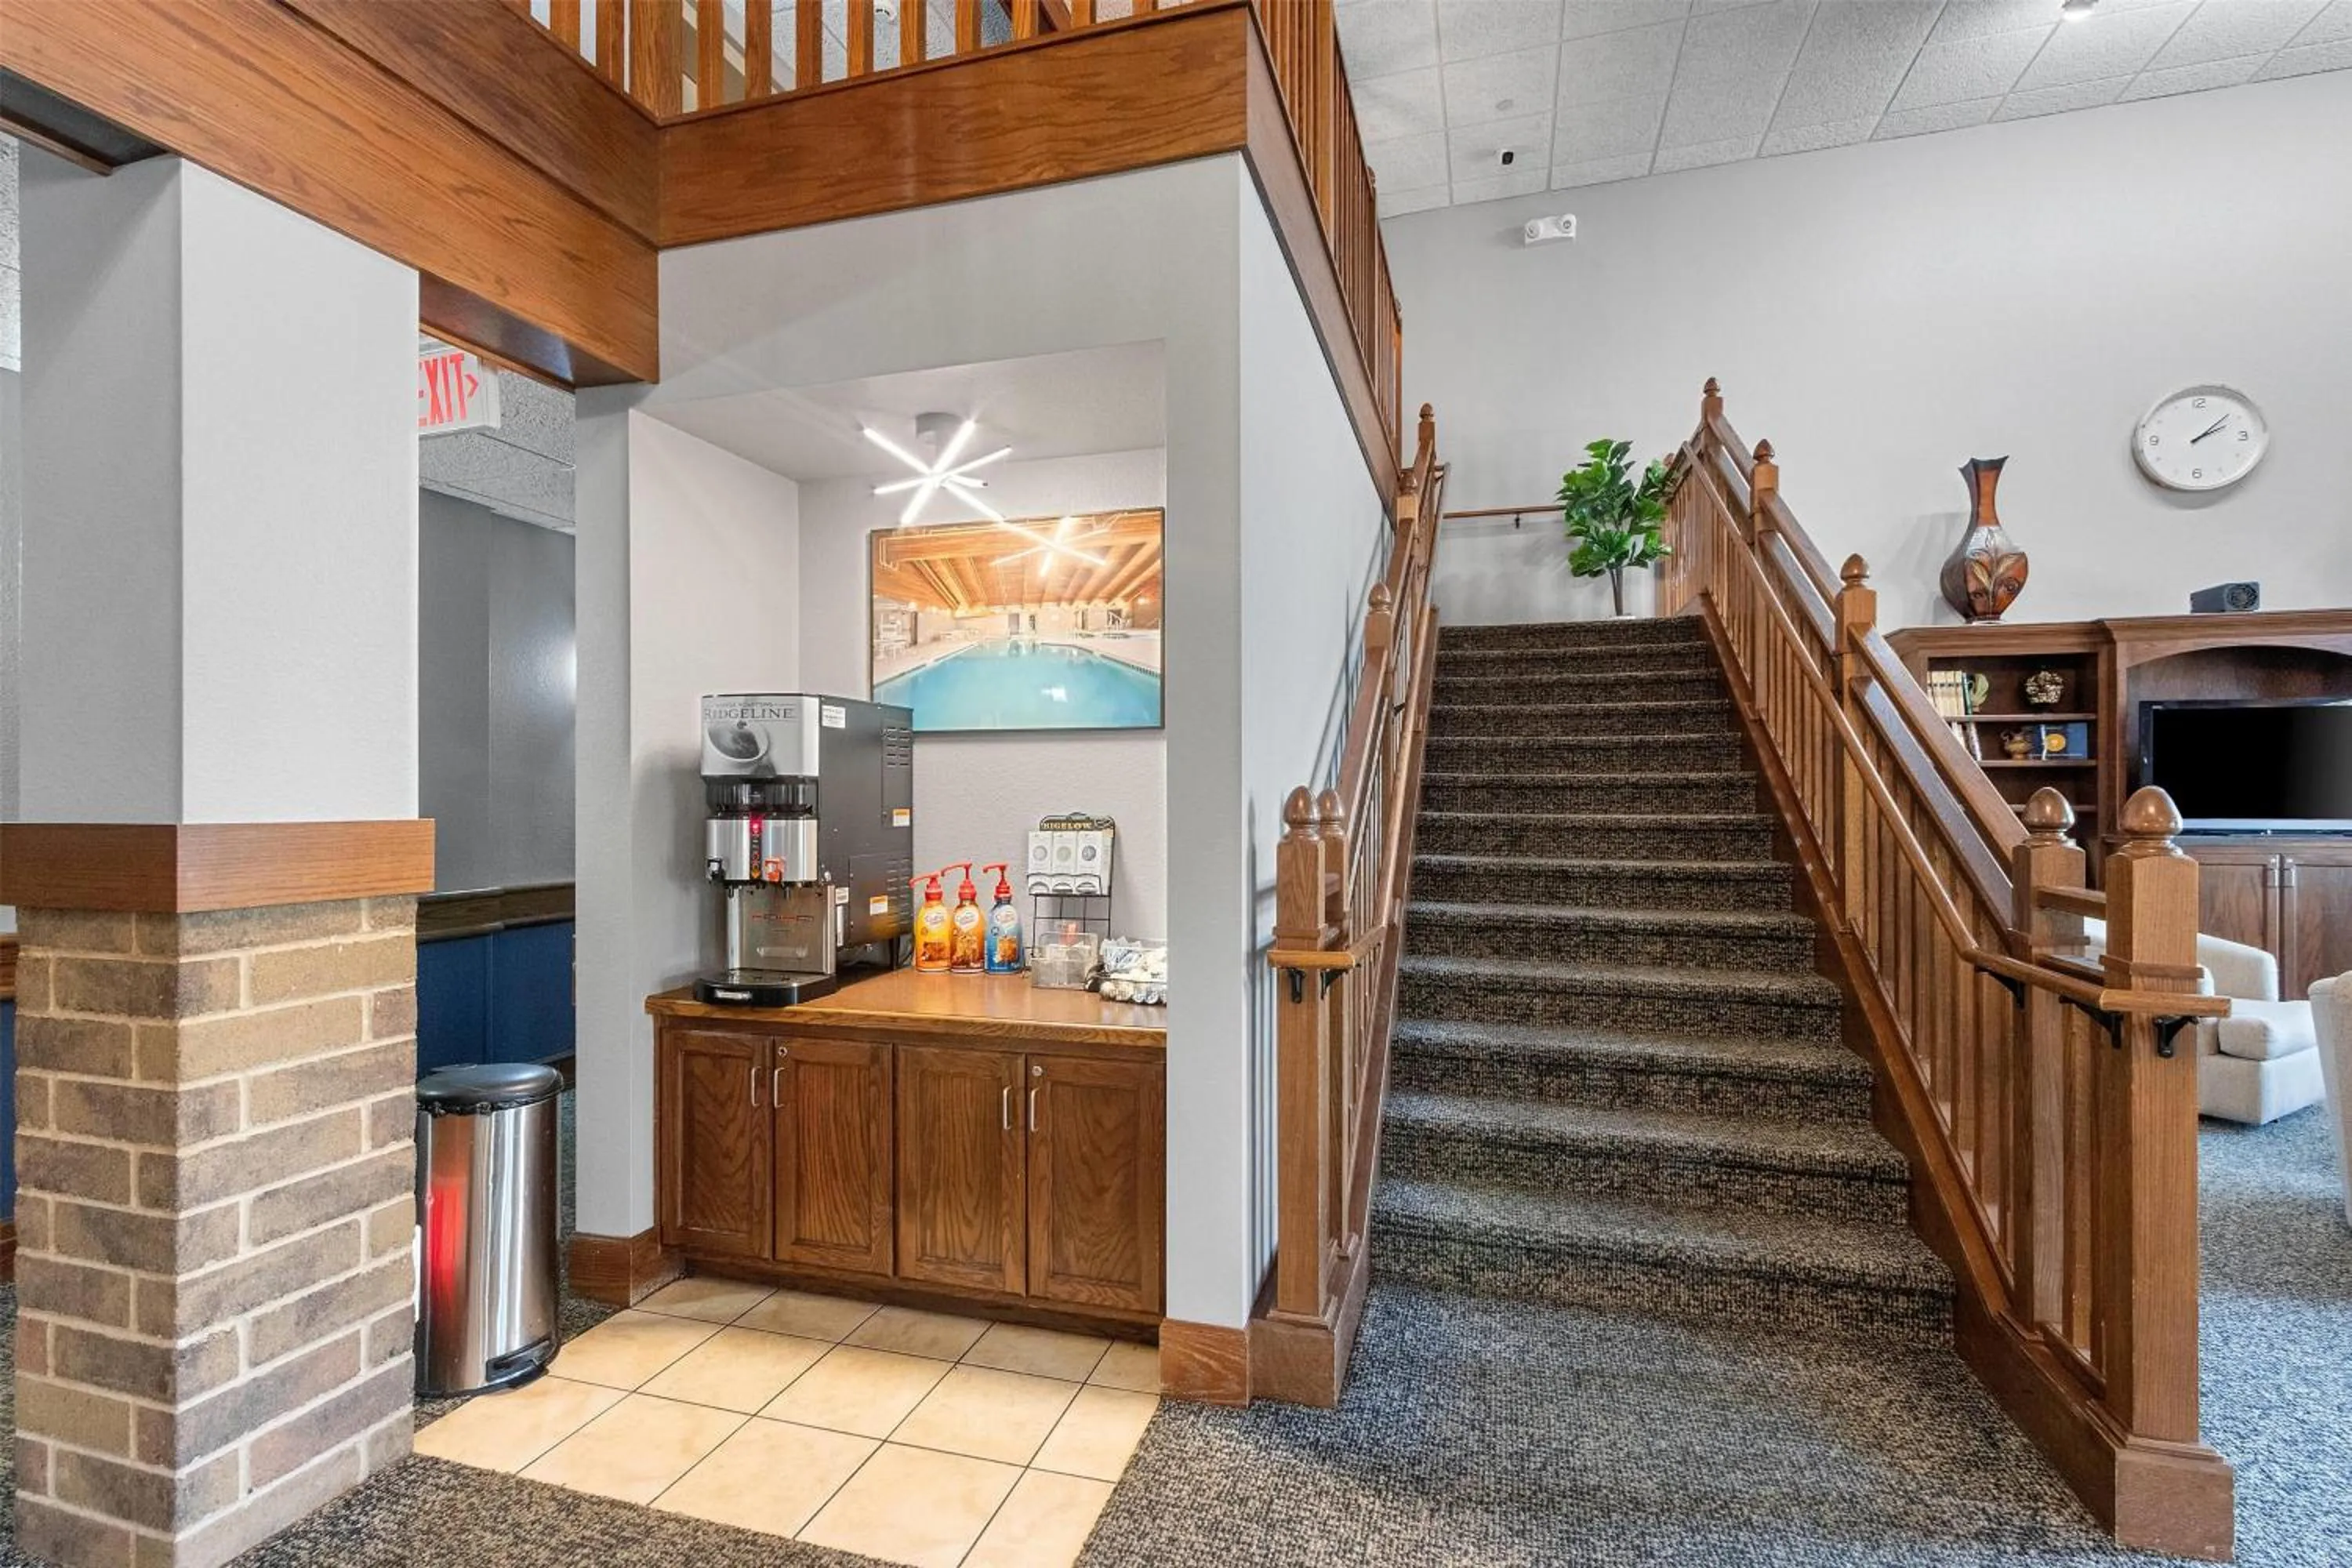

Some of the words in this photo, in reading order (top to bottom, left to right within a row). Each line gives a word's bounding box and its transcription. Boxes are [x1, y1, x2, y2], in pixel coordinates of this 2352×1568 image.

[2192, 397, 2206, 408] 12
[2149, 435, 2159, 446] 9
[2238, 430, 2249, 441] 3
[2192, 468, 2202, 479] 6
[704, 708, 794, 720] RIDGELINE
